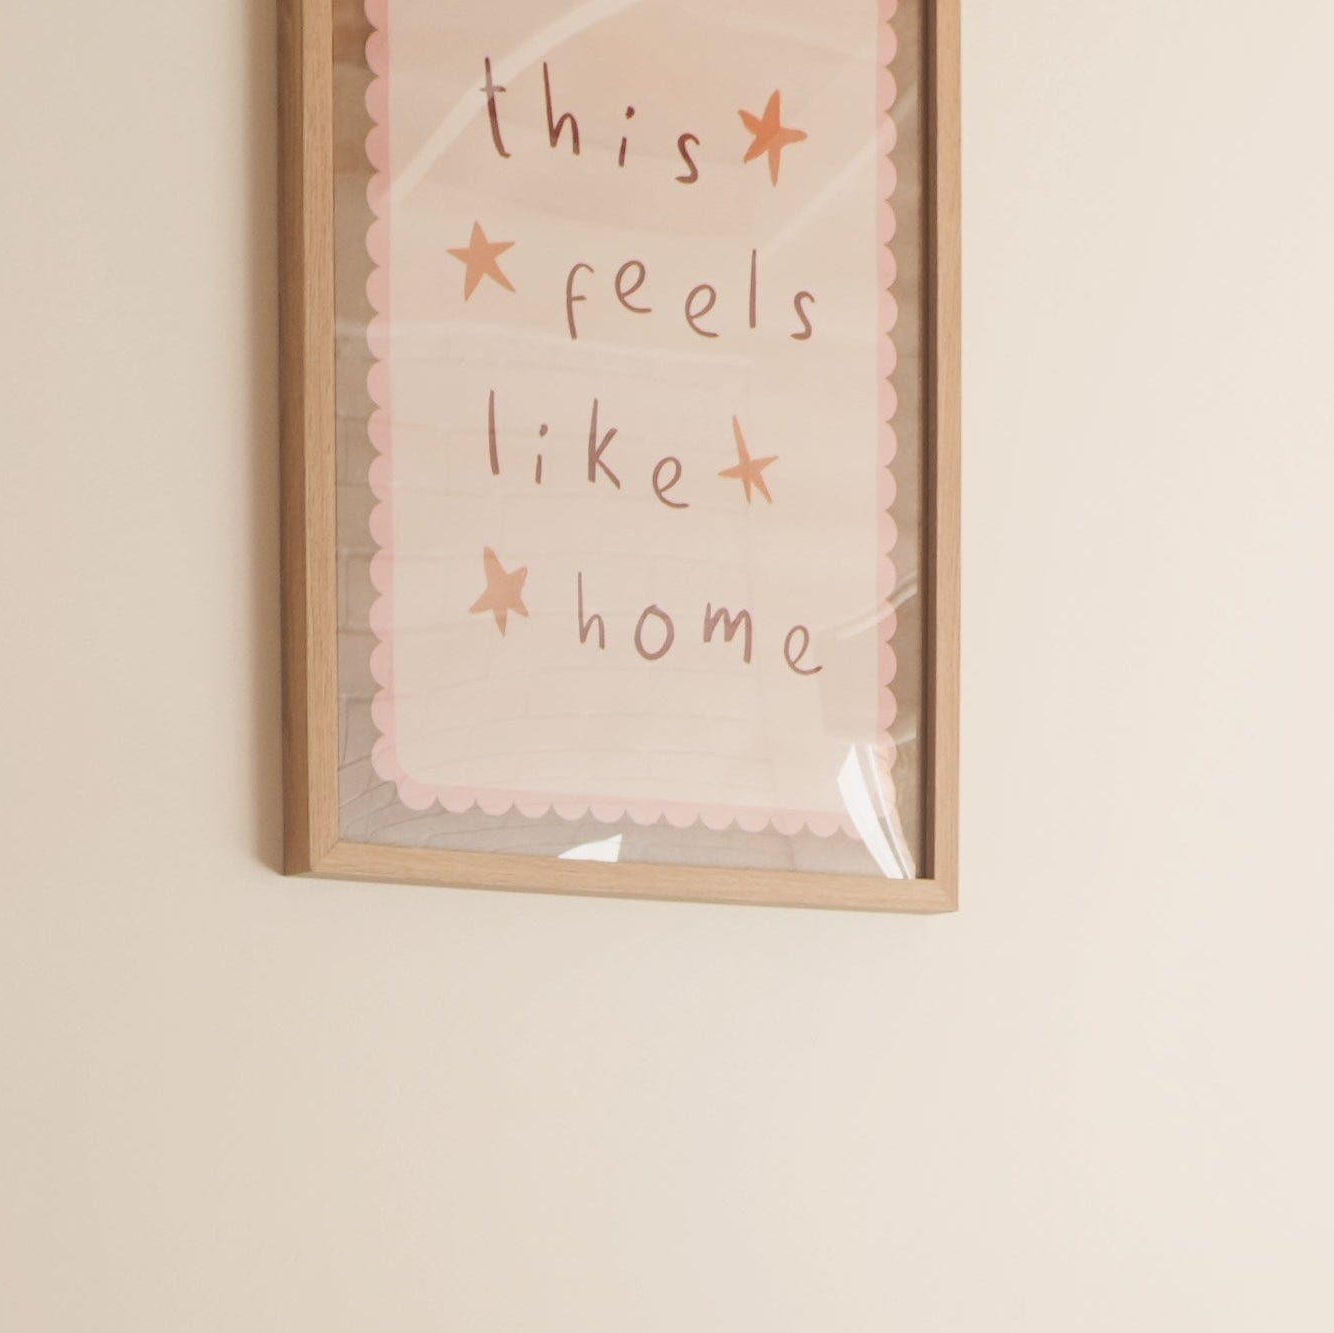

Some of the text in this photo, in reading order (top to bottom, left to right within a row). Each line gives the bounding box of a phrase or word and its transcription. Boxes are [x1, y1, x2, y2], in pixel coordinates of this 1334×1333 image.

[479, 56, 700, 184] this
[566, 249, 815, 340] feels
[488, 390, 690, 509] like
[577, 571, 823, 675] home
